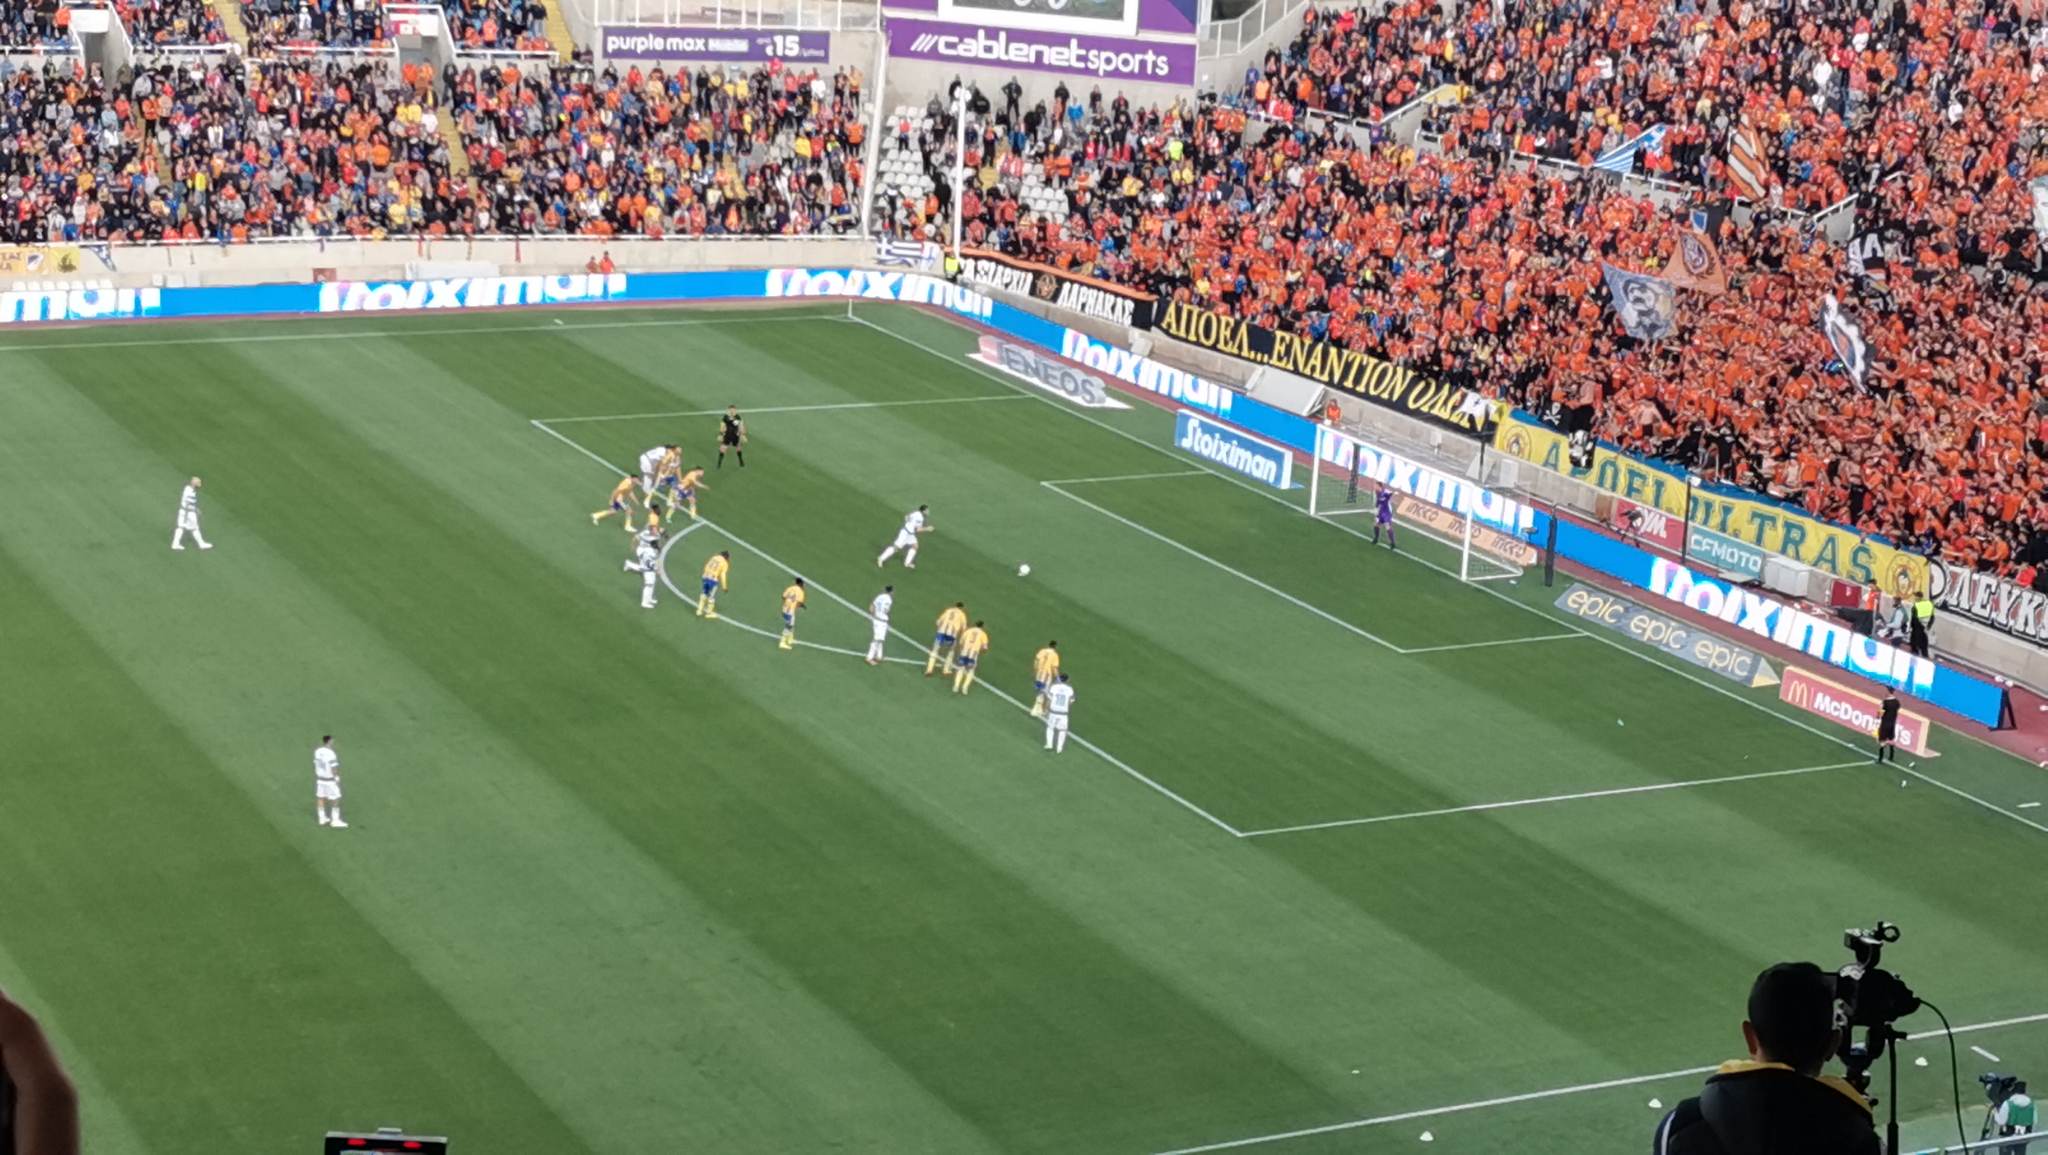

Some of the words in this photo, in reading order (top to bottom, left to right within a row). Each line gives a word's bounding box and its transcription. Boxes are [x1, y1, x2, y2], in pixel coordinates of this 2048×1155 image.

[606, 33, 666, 54] purple
[666, 35, 705, 52] max
[1005, 347, 1097, 404] ENEOS
[1181, 418, 1277, 483] Stoiximan
[1690, 534, 1761, 573] CFMOTO
[1567, 589, 1624, 623] epic
[1630, 614, 1686, 649] epic
[1695, 639, 1751, 676] epic
